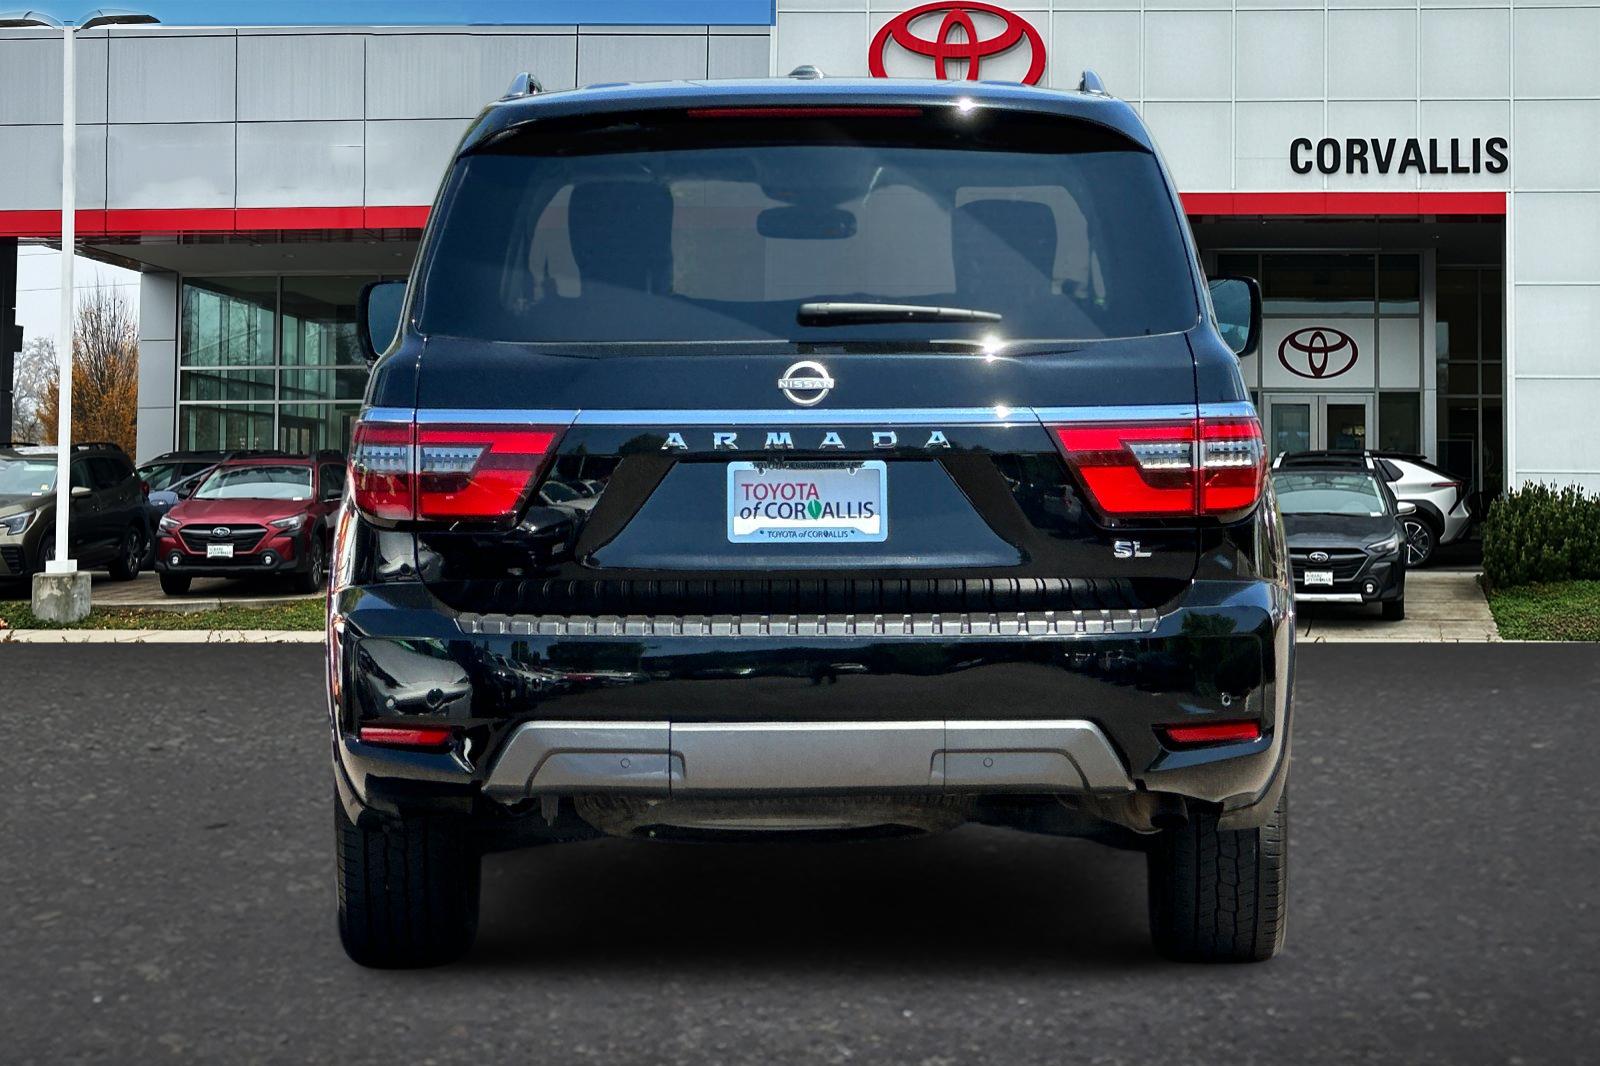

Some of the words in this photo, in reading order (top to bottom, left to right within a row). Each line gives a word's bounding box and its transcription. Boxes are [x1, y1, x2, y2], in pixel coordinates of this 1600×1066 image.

[1290, 137, 1509, 174] CORVALLIS
[779, 380, 834, 389] NISSAN
[660, 430, 951, 450] ARMADA
[741, 483, 820, 500] TOYOTA
[739, 501, 763, 519] of
[767, 530, 797, 538] TOYOTA
[798, 529, 808, 538] of
[1113, 540, 1152, 558] SL
